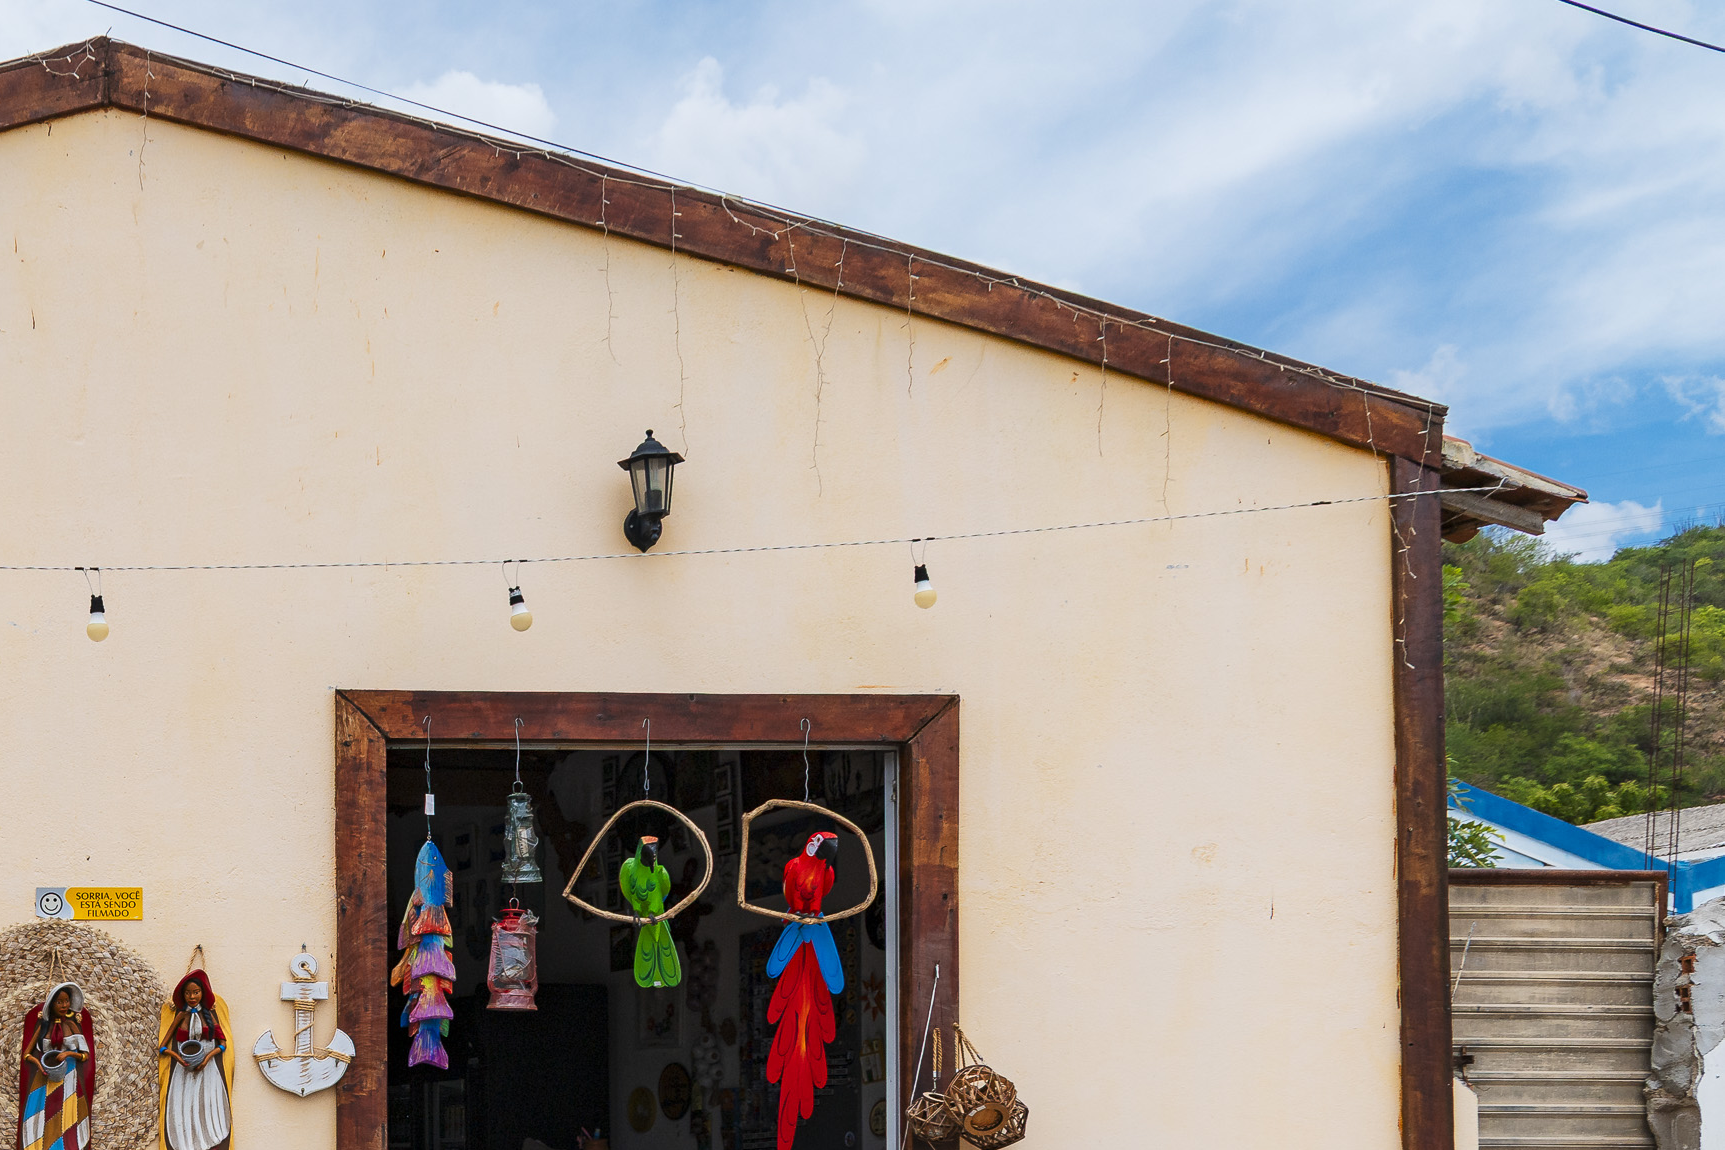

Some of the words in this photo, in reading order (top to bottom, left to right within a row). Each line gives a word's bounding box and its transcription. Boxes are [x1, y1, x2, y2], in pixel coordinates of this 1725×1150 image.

[75, 891, 113, 900] SORRIA,
[115, 890, 140, 900] VOCÊ
[80, 899, 101, 909] ESTÁ
[87, 909, 130, 917] FILMADO
